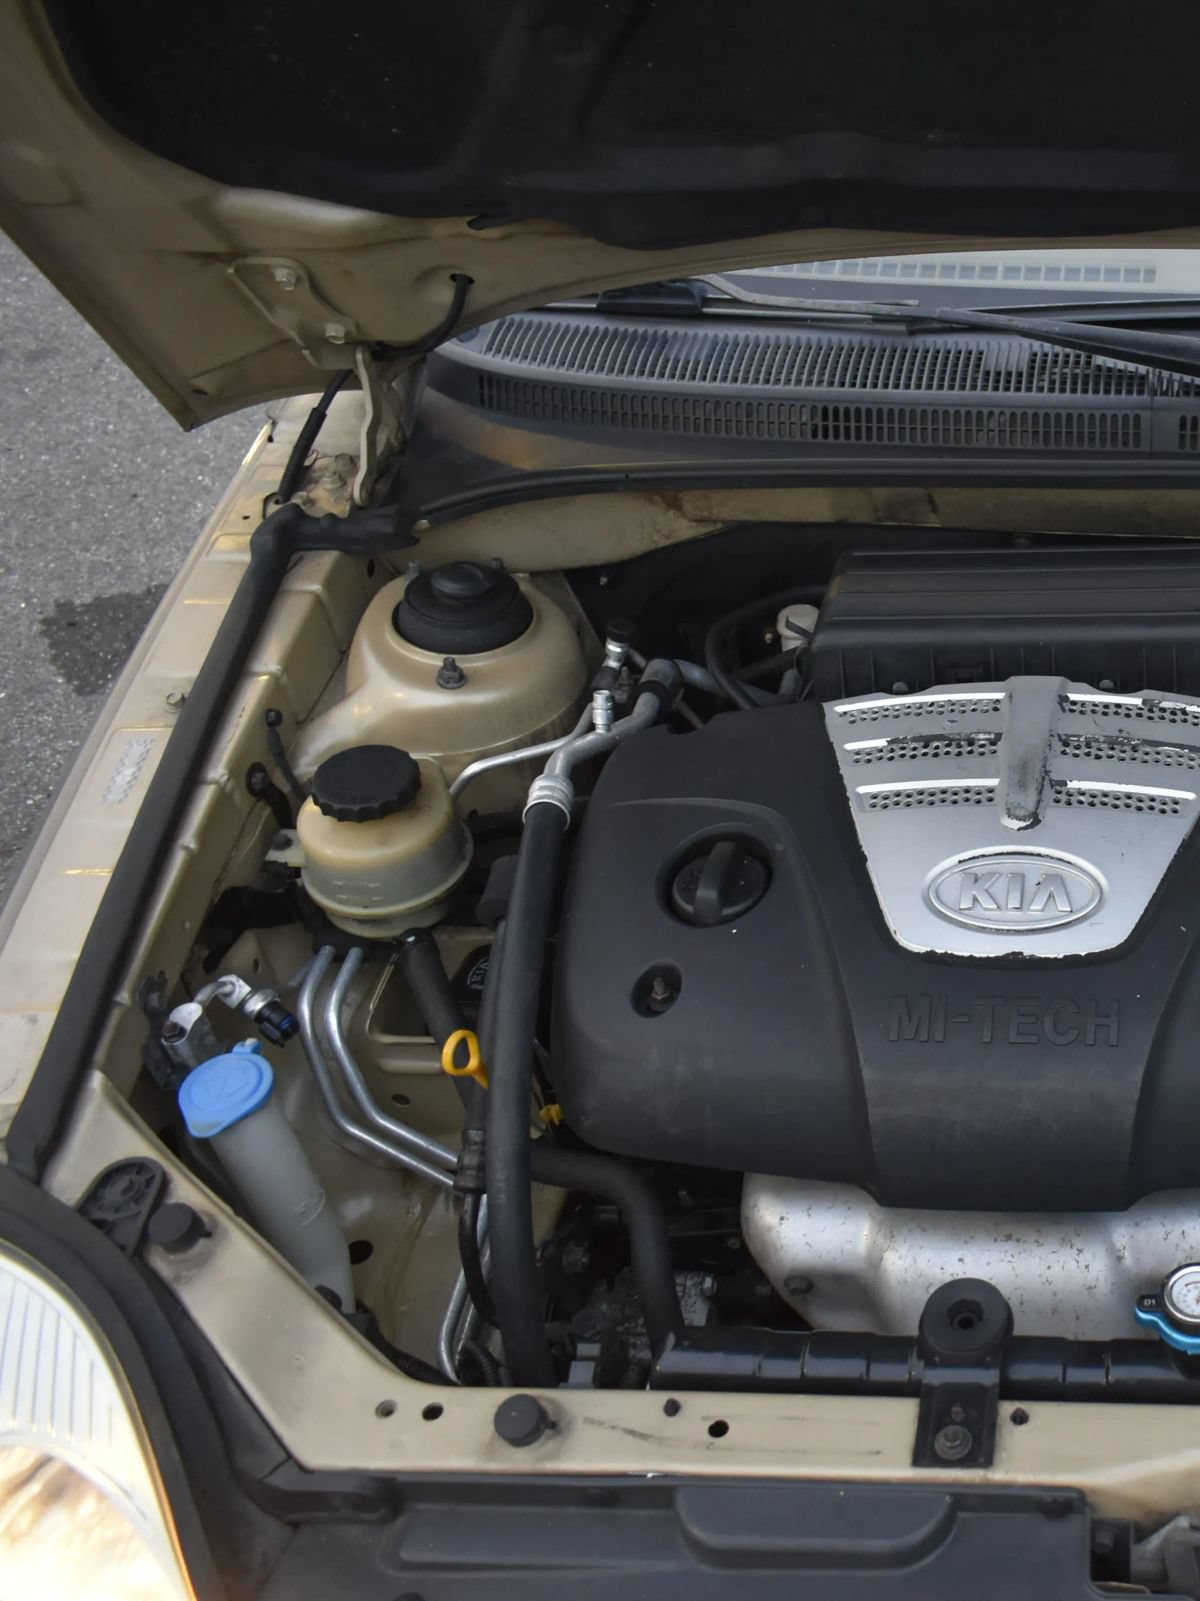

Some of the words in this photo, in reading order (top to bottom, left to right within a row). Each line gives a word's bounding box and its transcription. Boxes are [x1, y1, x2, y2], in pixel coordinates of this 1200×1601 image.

[958, 872, 1073, 914] KIA
[888, 994, 1120, 1047] MI-TECH
[1144, 1298, 1156, 1306] D1
